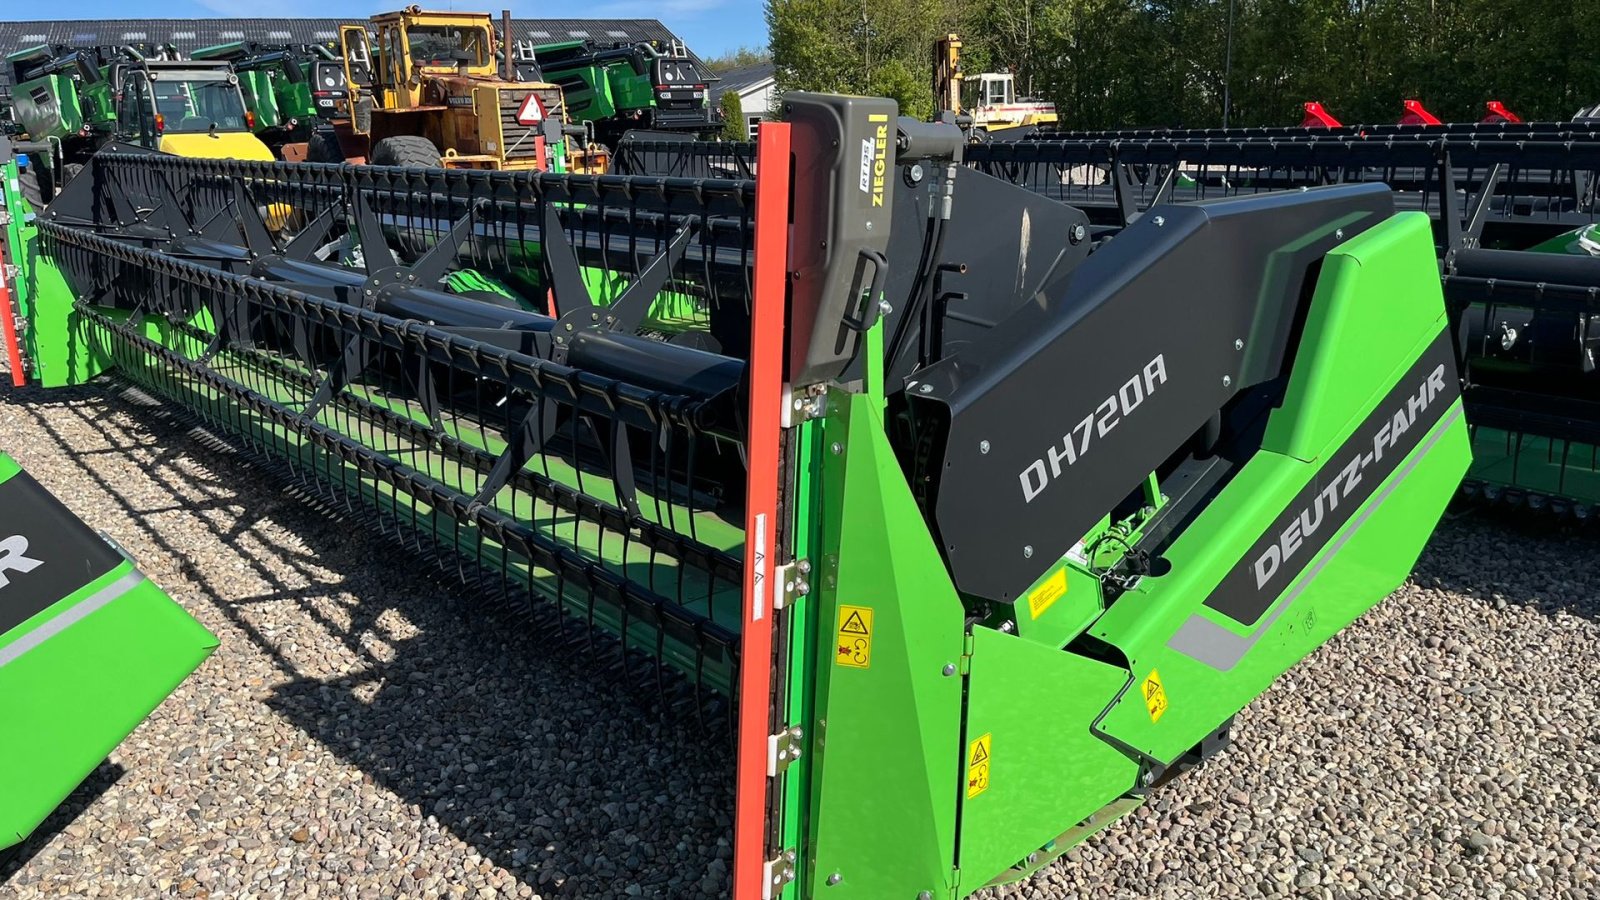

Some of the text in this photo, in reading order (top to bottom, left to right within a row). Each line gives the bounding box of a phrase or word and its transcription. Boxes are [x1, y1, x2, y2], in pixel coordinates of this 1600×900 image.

[872, 124, 888, 207] ZIEGLER
[1019, 353, 1167, 504] DH720A
[1254, 364, 1445, 590] DEUTZ-FAHR
